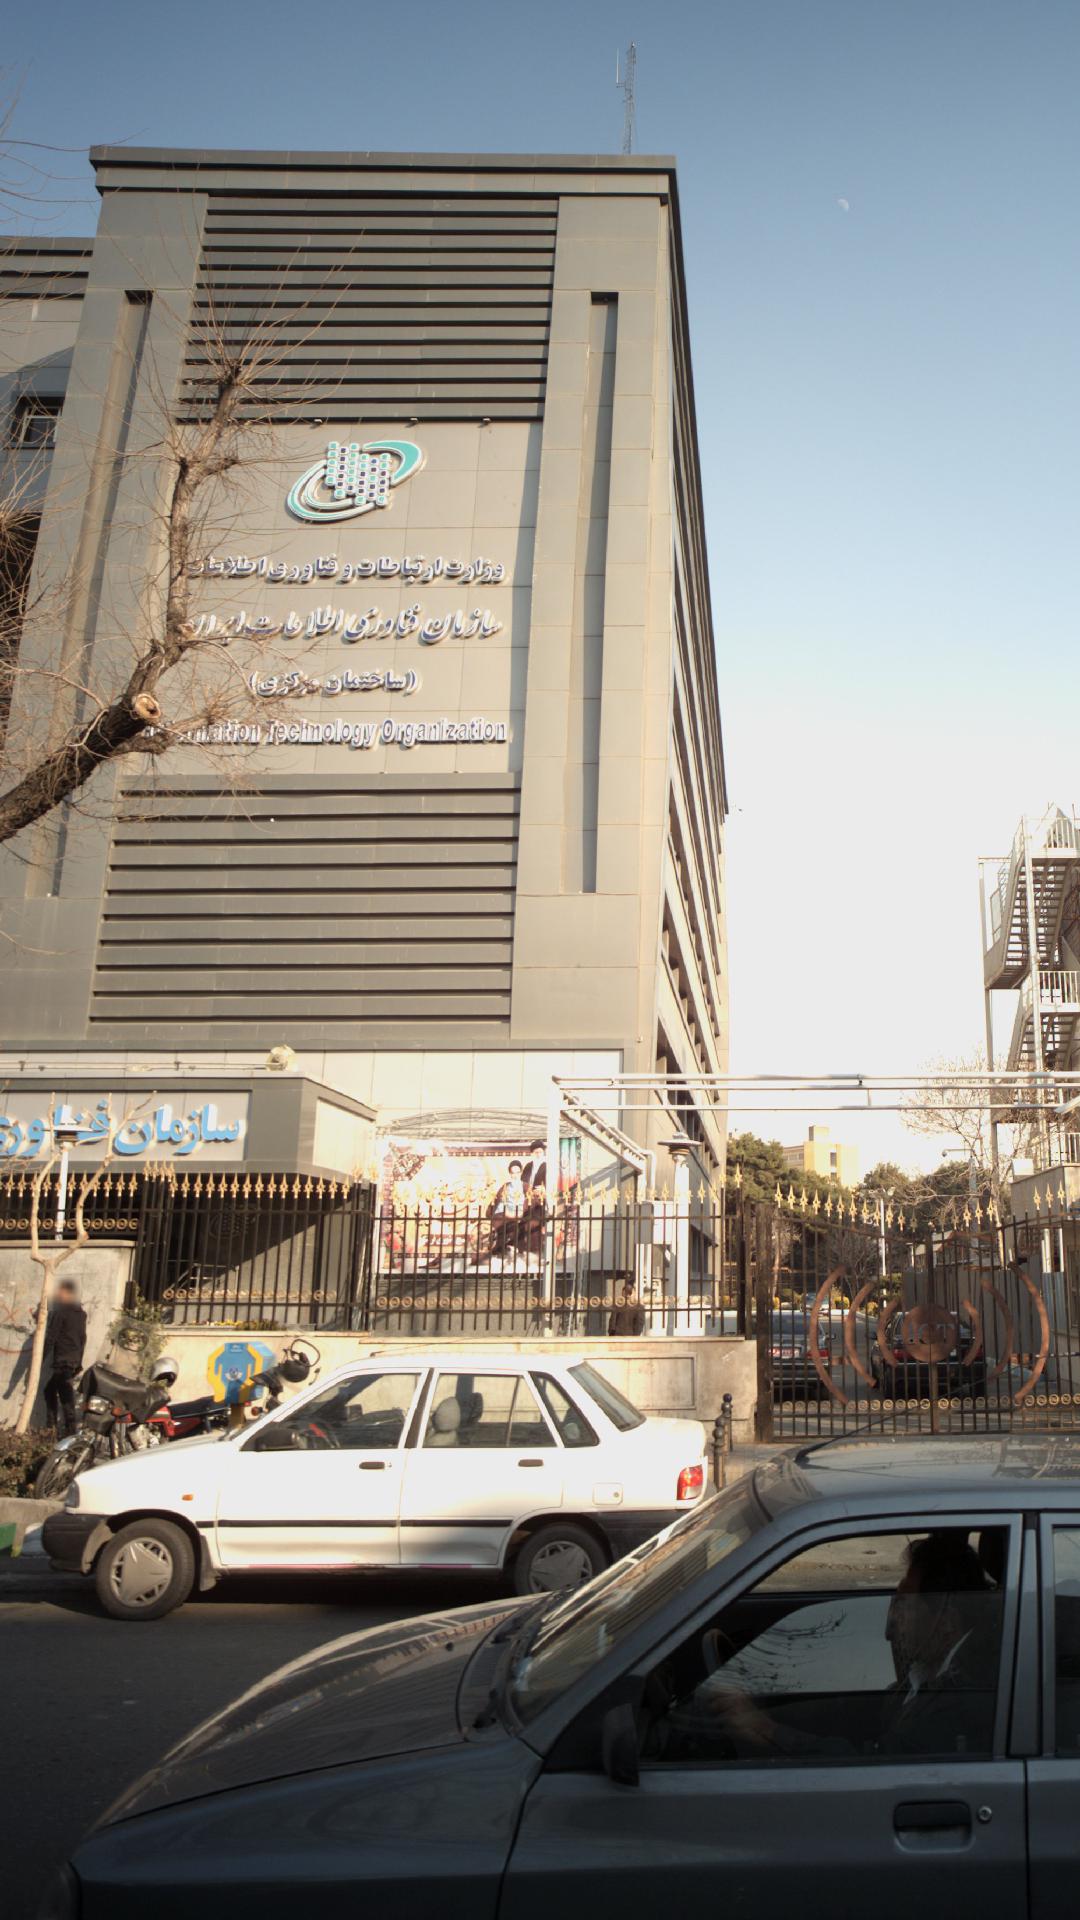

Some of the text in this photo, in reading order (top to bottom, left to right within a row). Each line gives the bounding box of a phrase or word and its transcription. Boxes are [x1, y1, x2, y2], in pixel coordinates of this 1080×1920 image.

[267, 553, 339, 583] فناوری
[342, 562, 353, 583] و
[356, 555, 444, 584] ارتباطات
[445, 556, 505, 583] وزارت
[343, 603, 421, 642] فناوری
[421, 607, 503, 643] سازمان
[266, 717, 376, 749] Technology
[381, 716, 508, 748] Organization
[113, 1103, 242, 1156] سازمان
[908, 1322, 955, 1345] ICT
